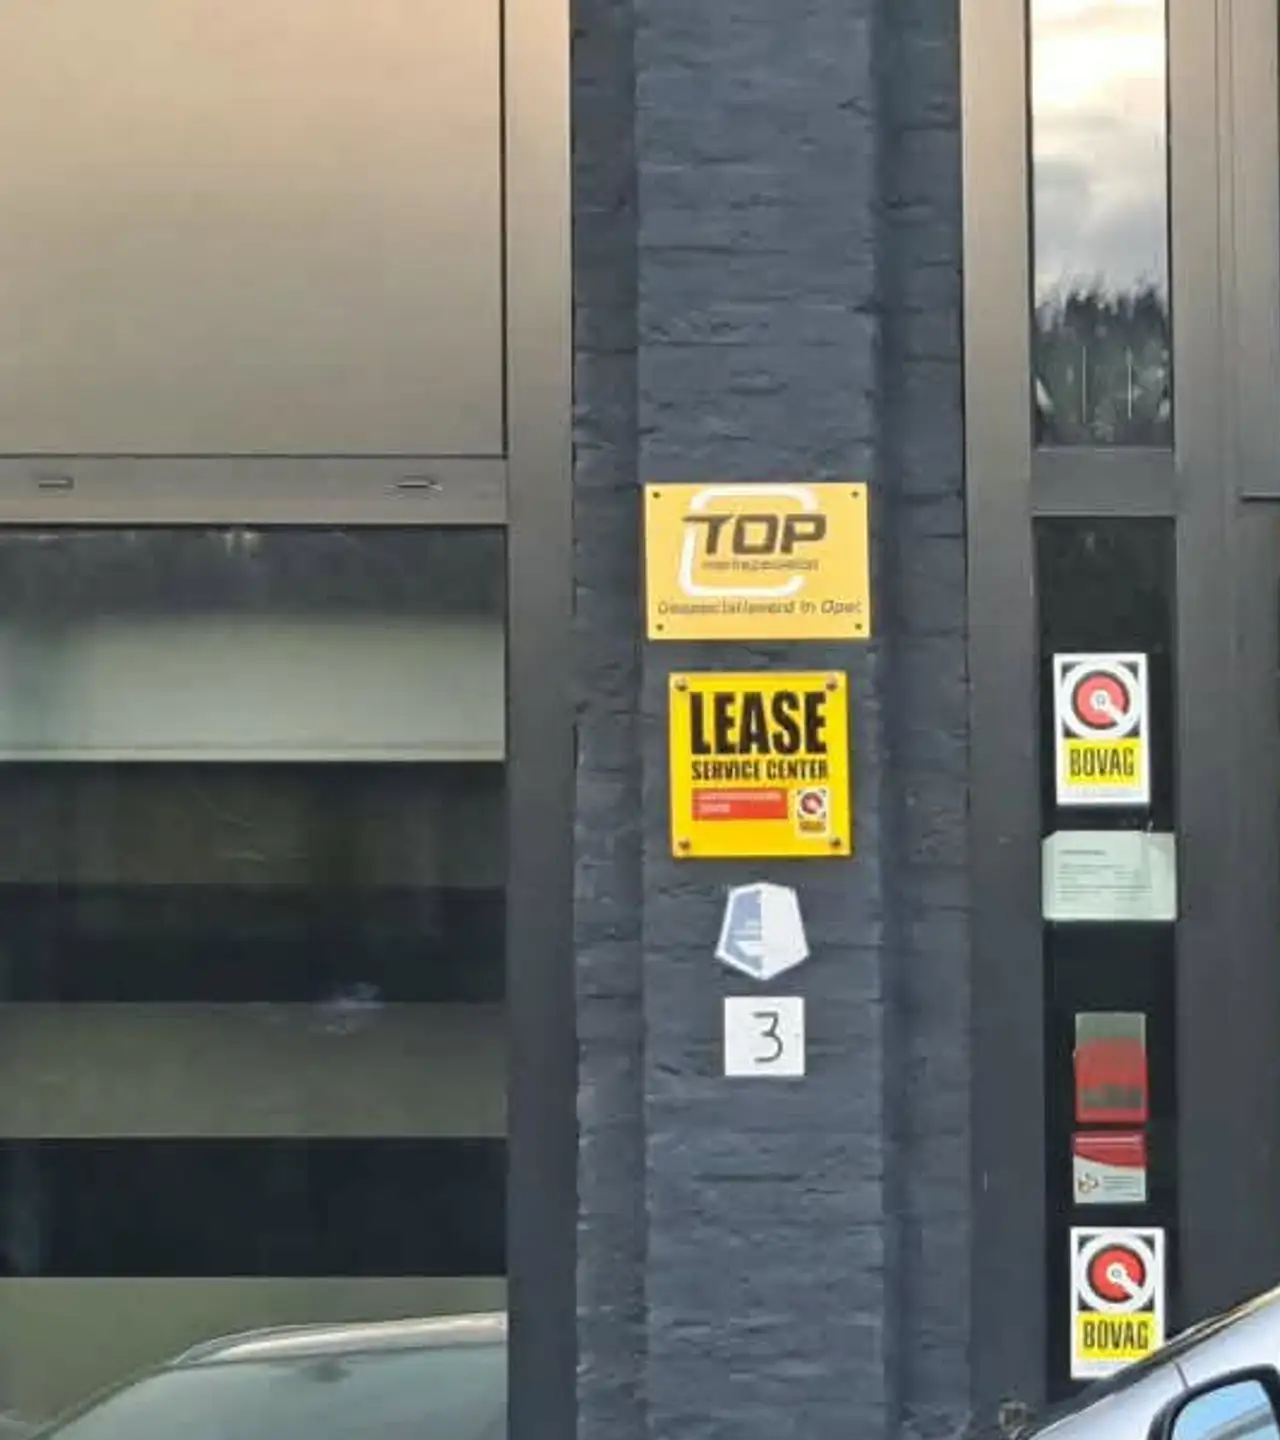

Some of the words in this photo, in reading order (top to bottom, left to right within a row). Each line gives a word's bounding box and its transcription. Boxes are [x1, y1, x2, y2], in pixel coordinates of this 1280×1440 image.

[682, 513, 827, 555] TOP
[690, 690, 828, 755] LEASE
[691, 759, 760, 780] SERVICE
[766, 759, 829, 780] CENTER
[1069, 747, 1135, 777] BOVAG
[752, 1011, 784, 1063] 3
[1082, 1319, 1149, 1350] BOVAG
